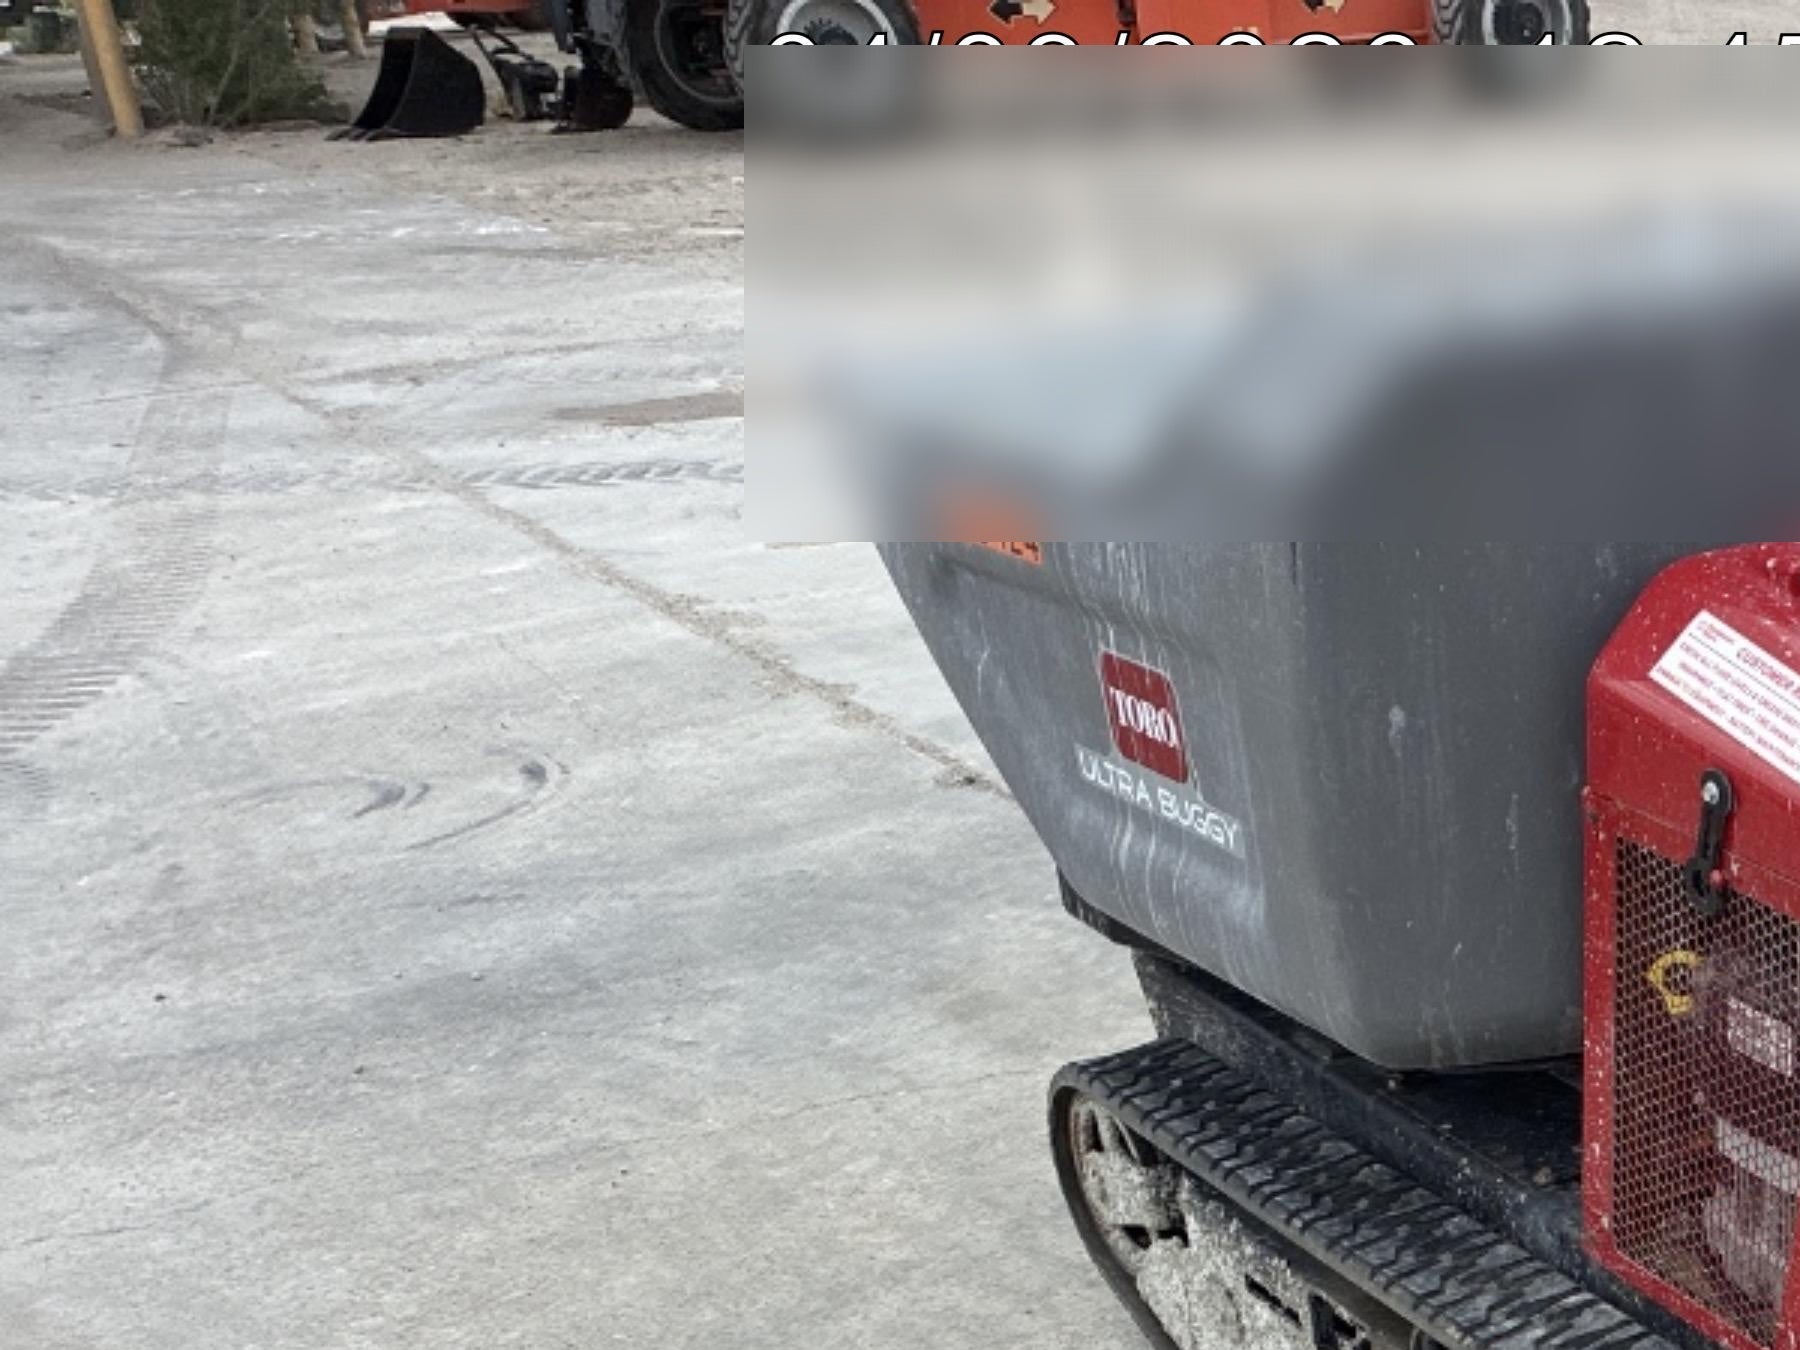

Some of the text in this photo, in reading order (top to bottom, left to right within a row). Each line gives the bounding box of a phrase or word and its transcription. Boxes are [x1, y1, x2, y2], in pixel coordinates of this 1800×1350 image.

[1109, 686, 1180, 749] TORO
[1078, 750, 1237, 849] ULTRA BUGGY
